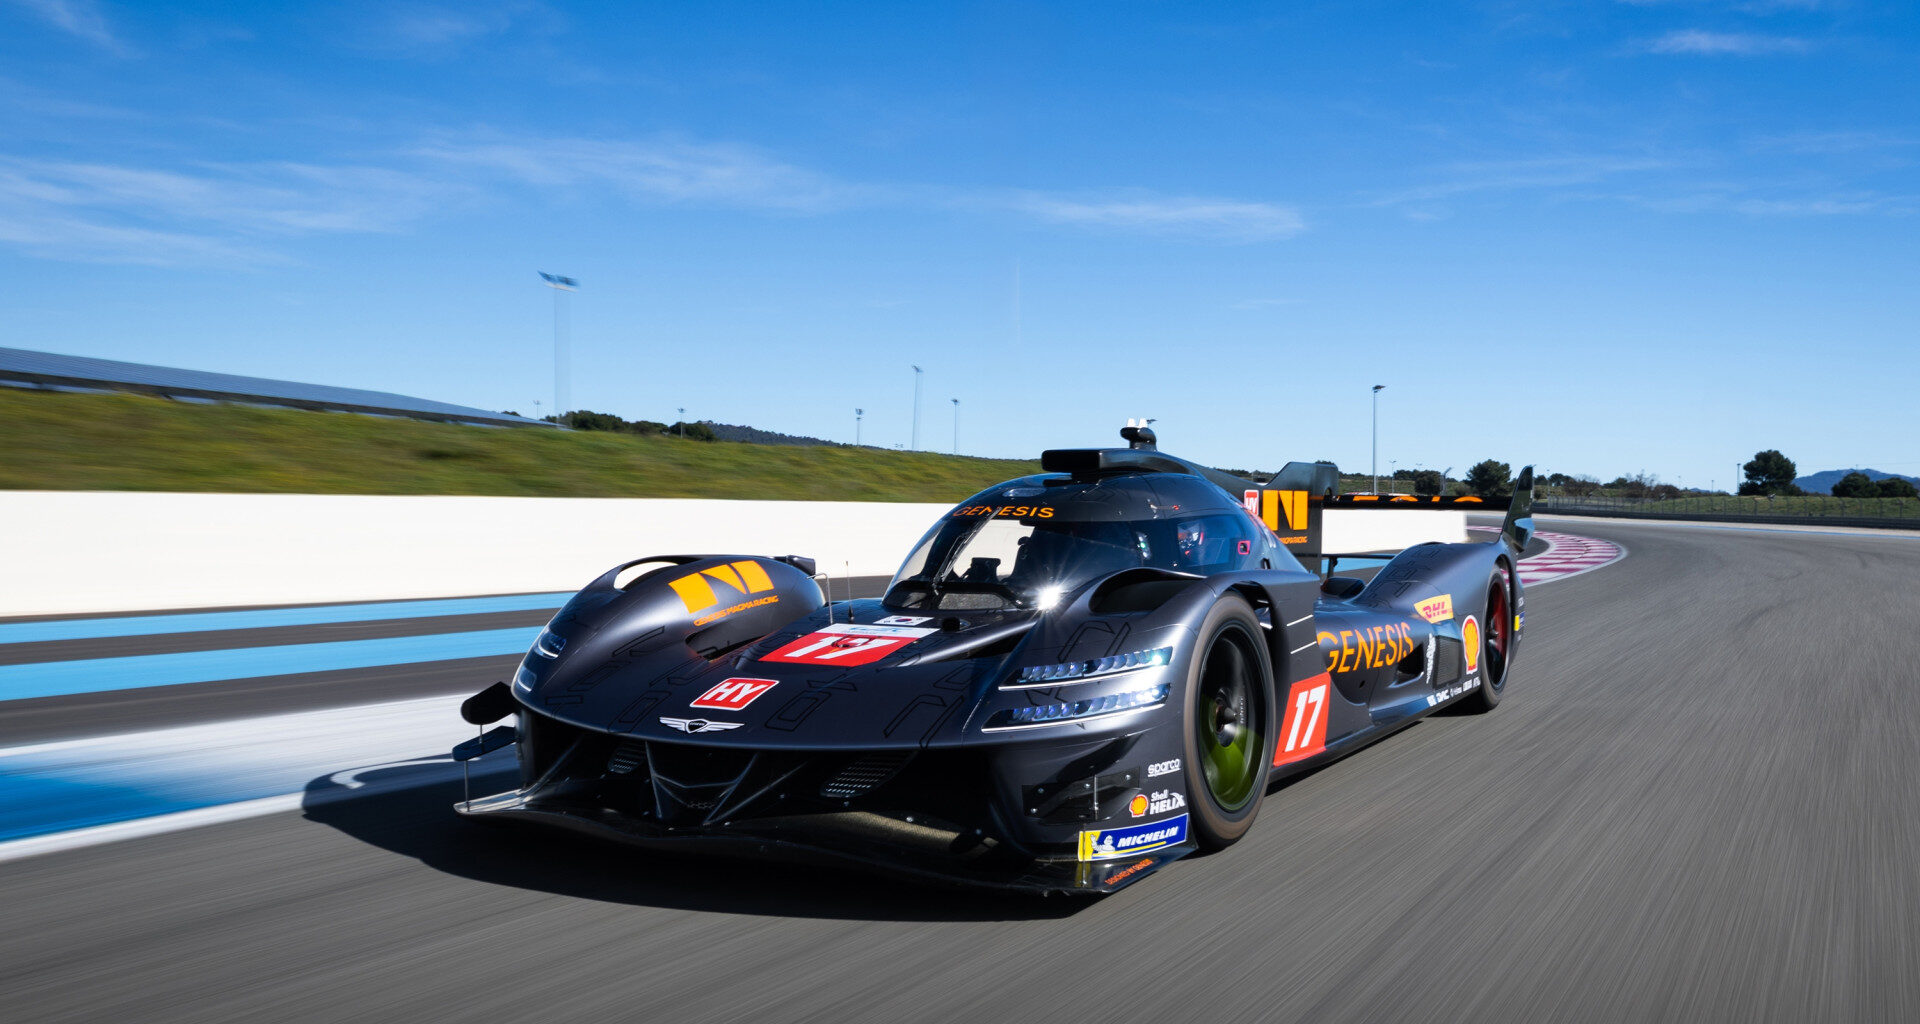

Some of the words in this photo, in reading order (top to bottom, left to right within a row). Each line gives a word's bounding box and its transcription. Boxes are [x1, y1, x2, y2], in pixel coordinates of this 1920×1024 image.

[784, 636, 900, 660] 17
[702, 682, 768, 703] HY
[1285, 684, 1327, 752] 17
[1147, 758, 1181, 777] sparco
[1149, 792, 1186, 815] HELIX
[1150, 789, 1168, 802] Shell
[1117, 826, 1179, 848] MICHELIN
